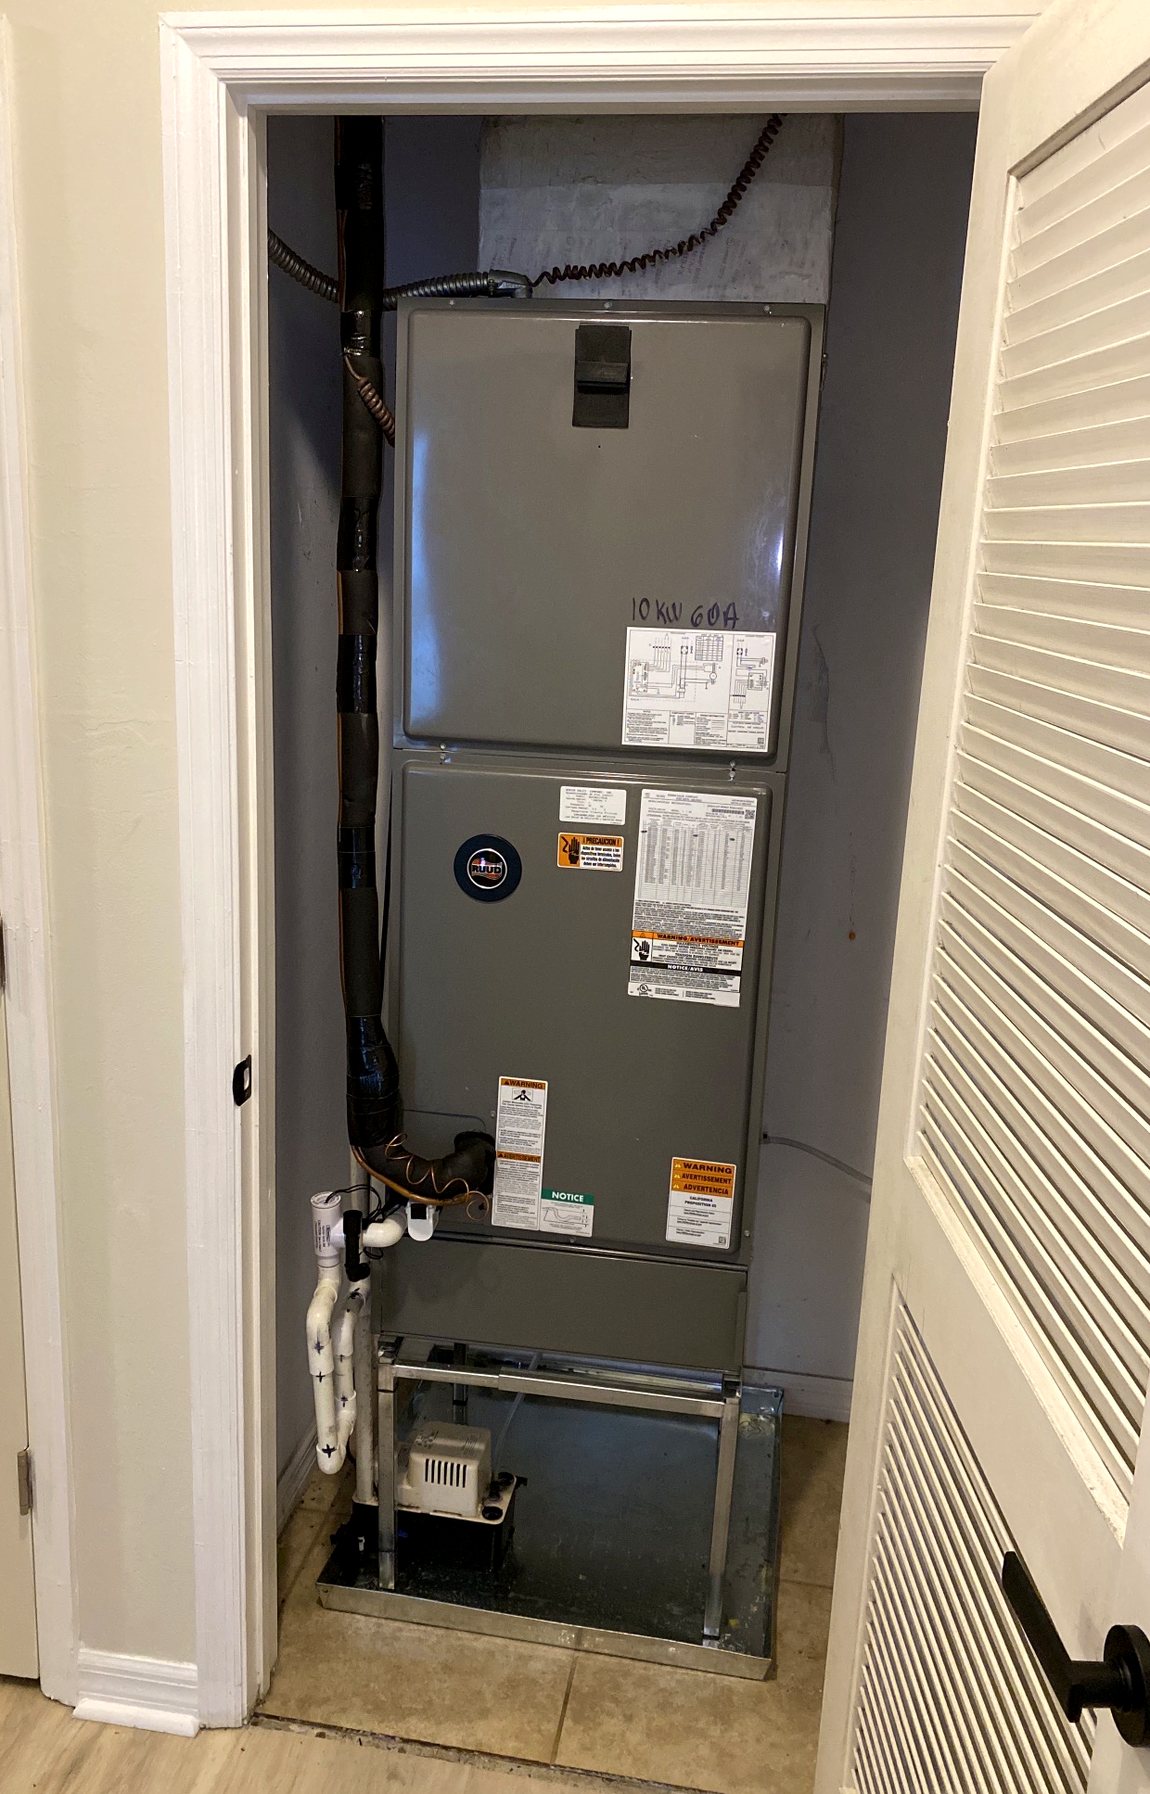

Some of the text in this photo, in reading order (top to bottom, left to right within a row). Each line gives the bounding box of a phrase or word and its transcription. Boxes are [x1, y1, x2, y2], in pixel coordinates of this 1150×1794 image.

[472, 865, 502, 874] RUUD
[510, 1080, 543, 1089] WARNING
[683, 1162, 732, 1174] WARNING
[682, 1173, 731, 1184] AVERTISSEMENT
[684, 1183, 728, 1195] ADVERTENCIA
[551, 1191, 584, 1202] NOTICE
